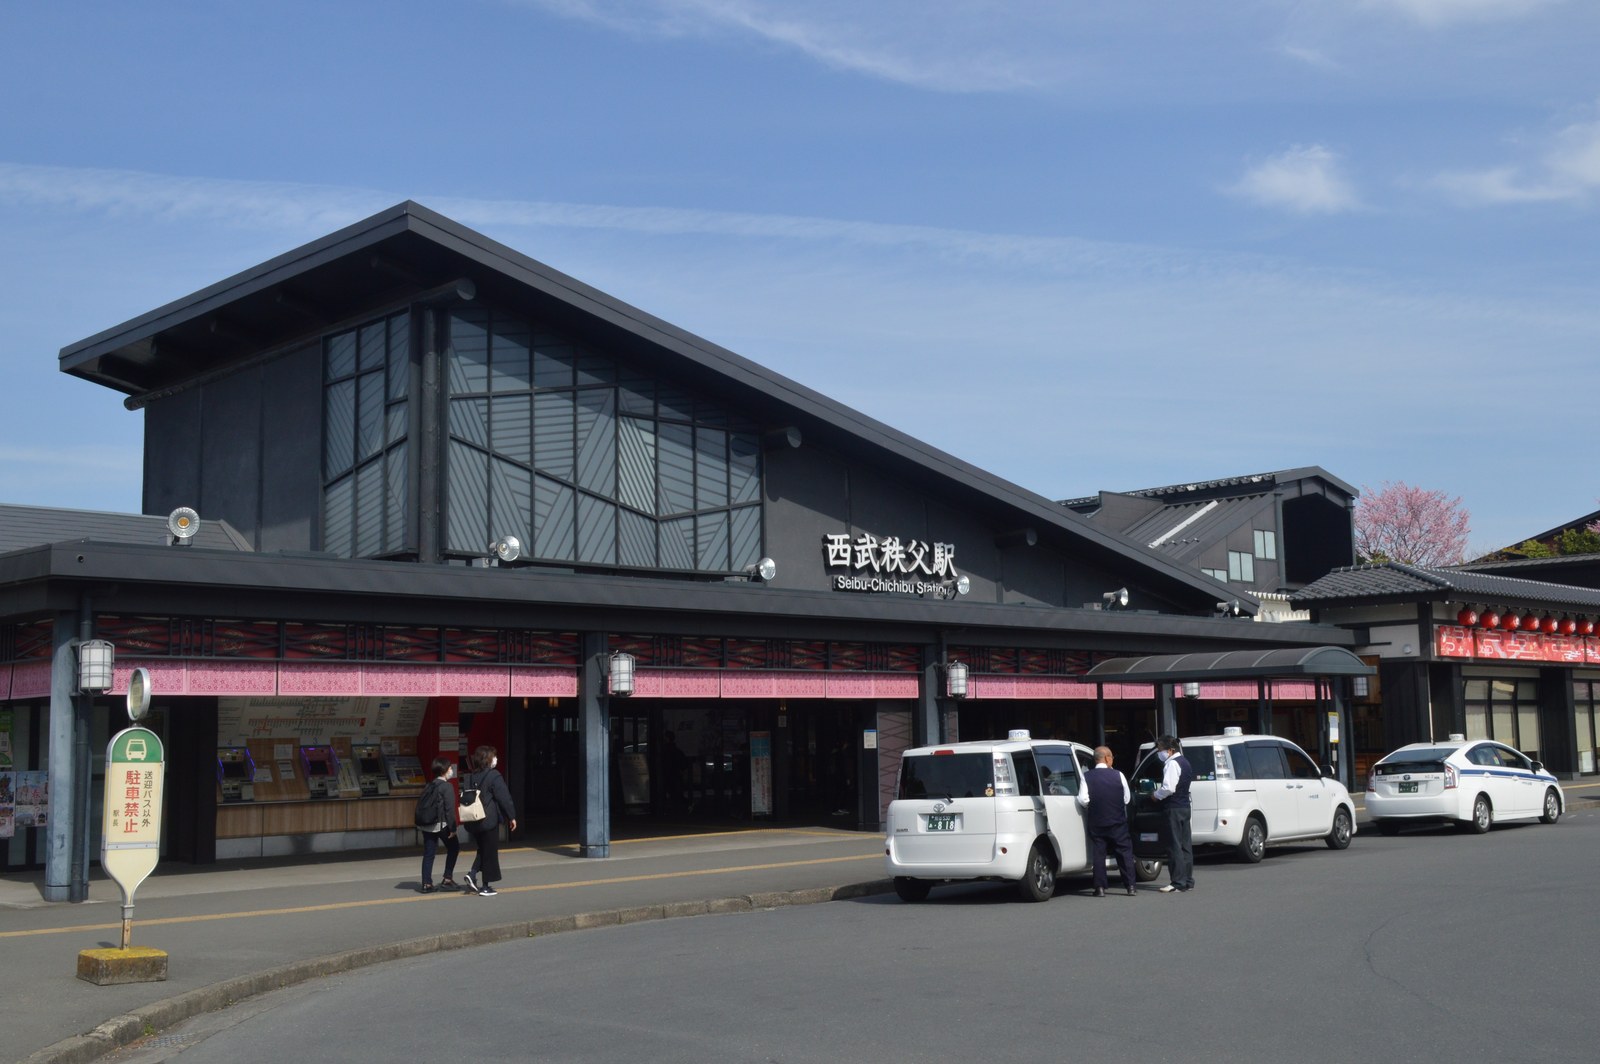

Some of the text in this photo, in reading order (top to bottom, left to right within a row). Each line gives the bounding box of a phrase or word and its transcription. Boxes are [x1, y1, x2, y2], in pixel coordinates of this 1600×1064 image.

[826, 533, 957, 576] 西武秩父駅
[837, 576, 915, 593] Seibu-Chichibu
[124, 770, 140, 833] 駐車禁止
[142, 770, 153, 828] 送迎バス以外
[112, 809, 120, 827] 駅長
[937, 820, 955, 830] 818
